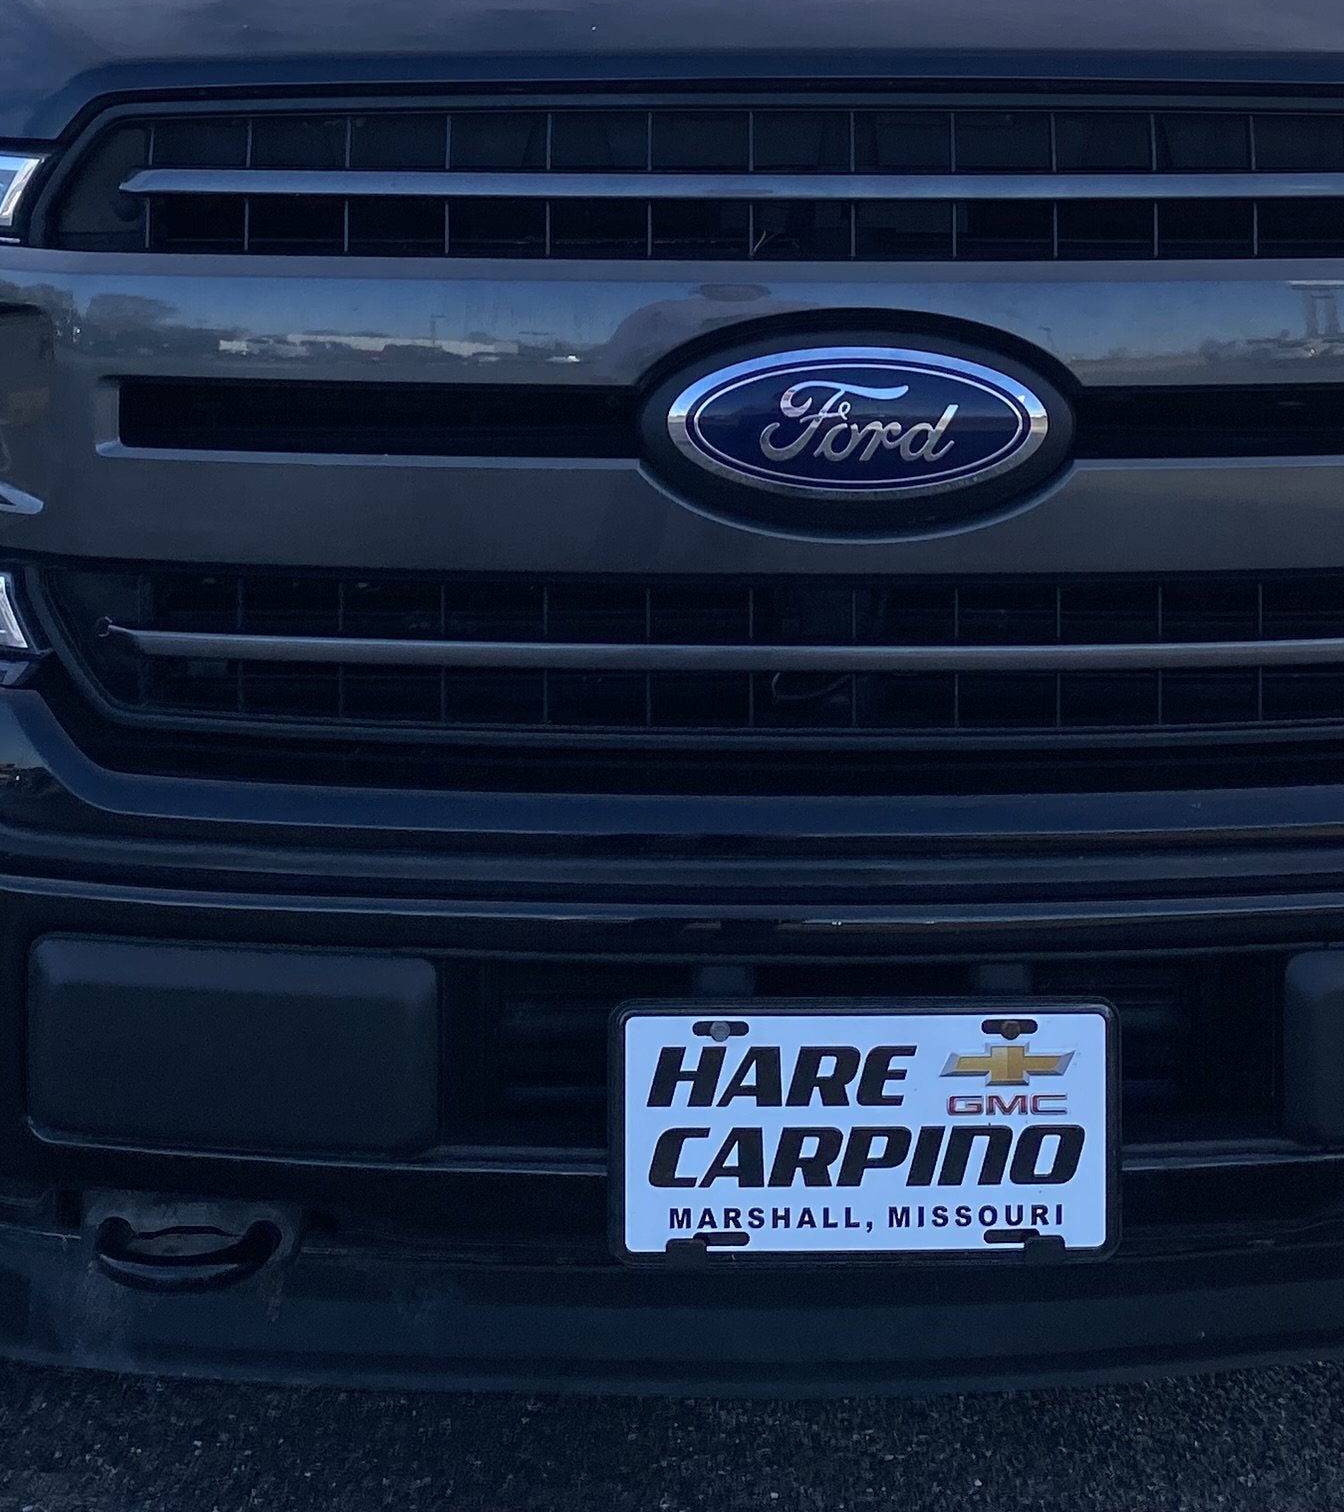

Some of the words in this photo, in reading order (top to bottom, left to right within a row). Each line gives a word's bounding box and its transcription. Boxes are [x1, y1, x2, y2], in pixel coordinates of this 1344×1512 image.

[760, 380, 958, 462] Ford
[646, 1044, 918, 1108] HARE
[946, 1093, 1068, 1116] GMC
[647, 1123, 1086, 1188] CARPINO
[668, 1205, 874, 1232] MARSHALL,
[887, 1203, 1065, 1228] MISSOURI
